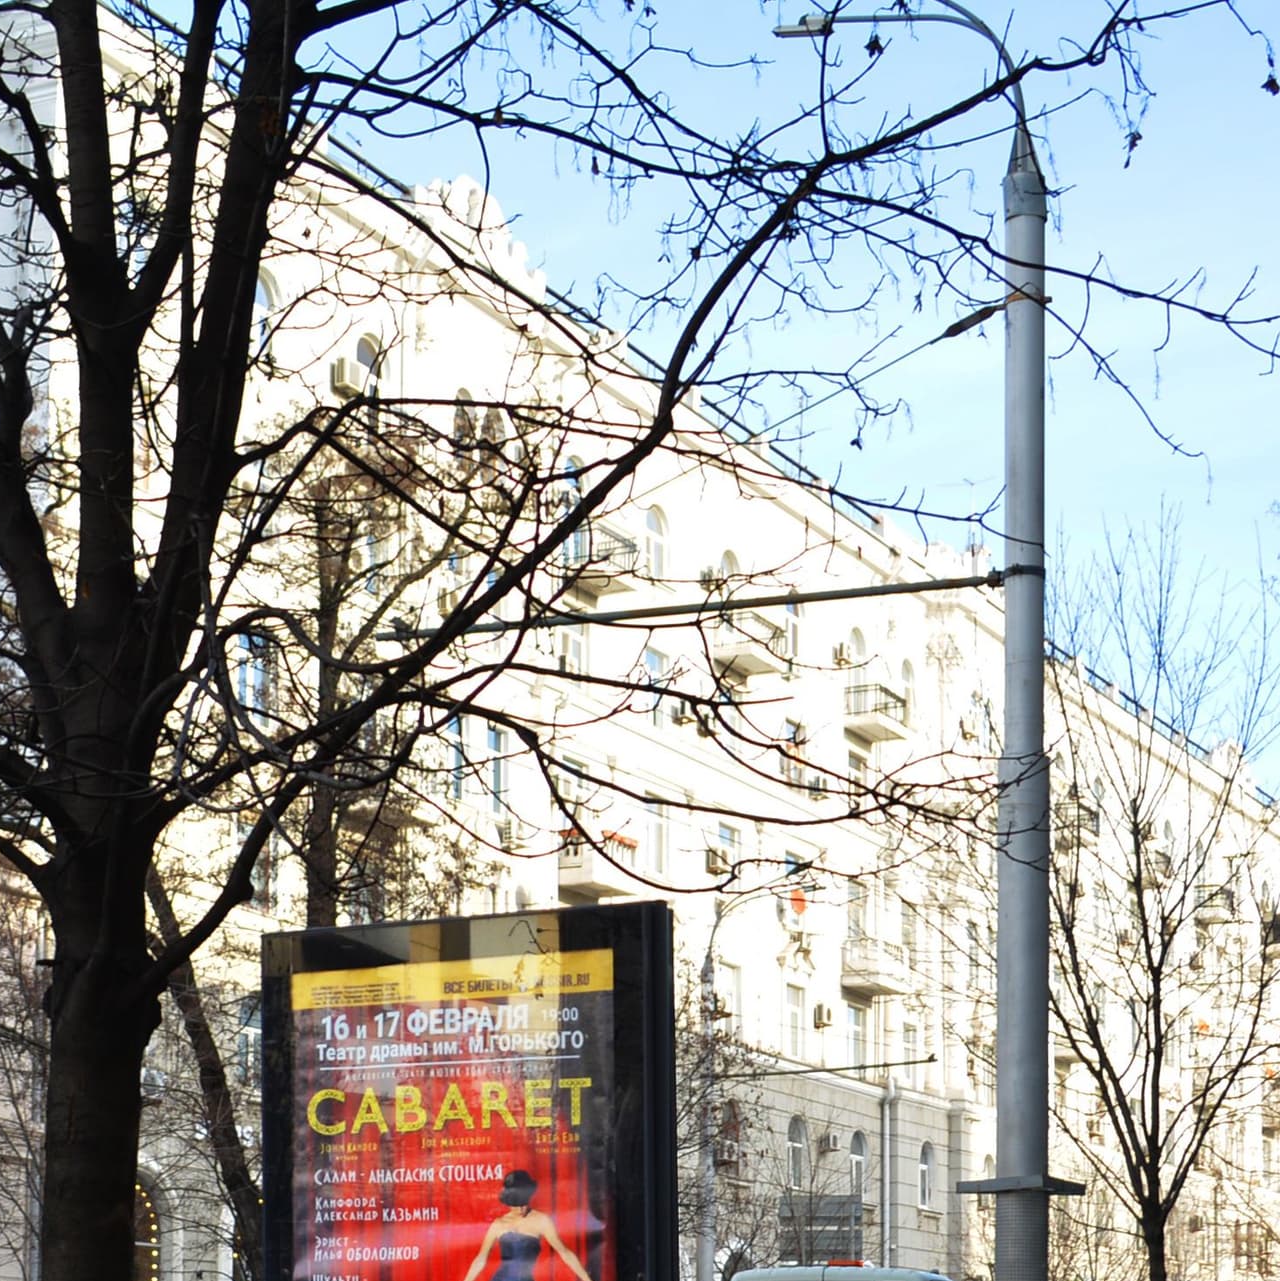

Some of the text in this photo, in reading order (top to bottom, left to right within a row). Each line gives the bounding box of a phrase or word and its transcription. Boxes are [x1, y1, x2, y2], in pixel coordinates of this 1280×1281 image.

[443, 980, 465, 994] ВСЕ
[467, 979, 513, 993] БИЛЕТЫ
[321, 1013, 350, 1041] 16
[373, 1010, 401, 1038] 17
[406, 1003, 529, 1036] ФЕВРАЛЯ
[542, 1007, 579, 1022] 19:00
[316, 1044, 366, 1063] Театр
[370, 1041, 428, 1063] драмы
[432, 1041, 463, 1056] им.
[306, 1077, 593, 1136] CABARET
[314, 1168, 356, 1185] САЛЛИ
[368, 1167, 435, 1184] АНАСТАСИЯ
[438, 1164, 503, 1182] СТОЦКАЯ
[315, 1207, 439, 1224] АЛЕКСАНДР КАЗЬМИН
[315, 1236, 349, 1249] ЭРНСТ
[346, 1246, 420, 1262] ОБОЛОНКОВ
